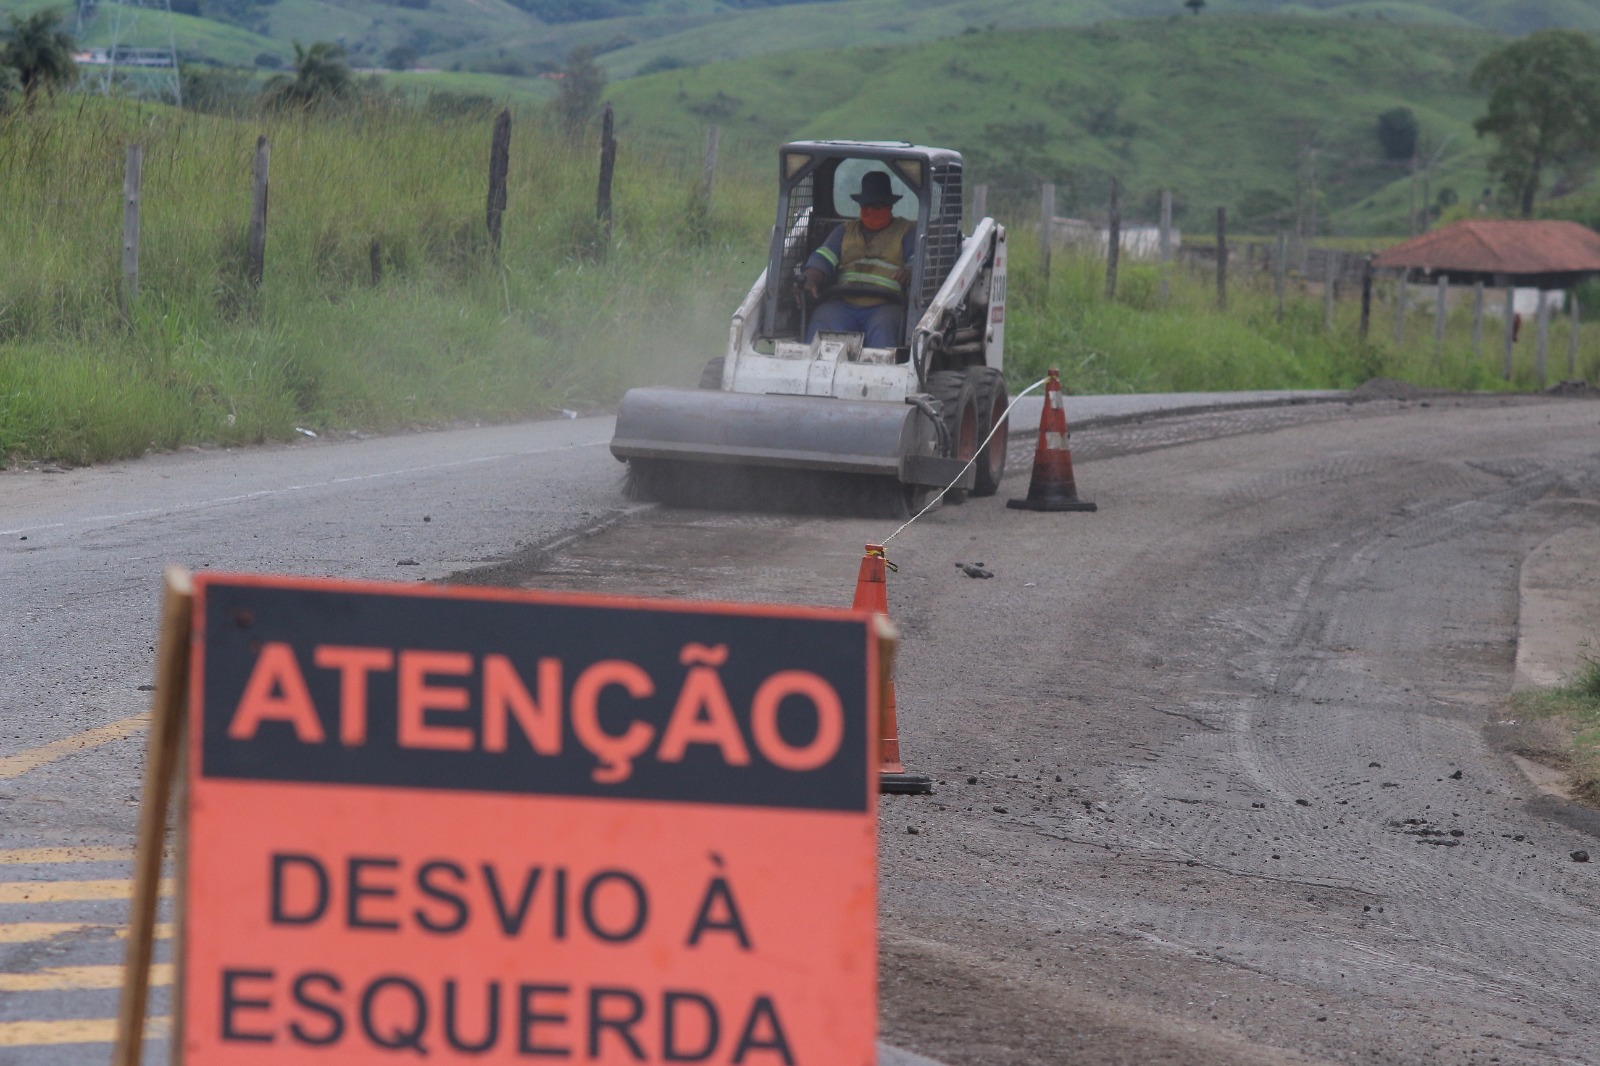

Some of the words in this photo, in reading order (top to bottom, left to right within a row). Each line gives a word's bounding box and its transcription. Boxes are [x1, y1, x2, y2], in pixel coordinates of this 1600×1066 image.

[229, 644, 844, 783] ATENÇÃO
[269, 851, 651, 945] DESVIO
[685, 852, 754, 951] À
[219, 967, 797, 1066] ESQUERDA
